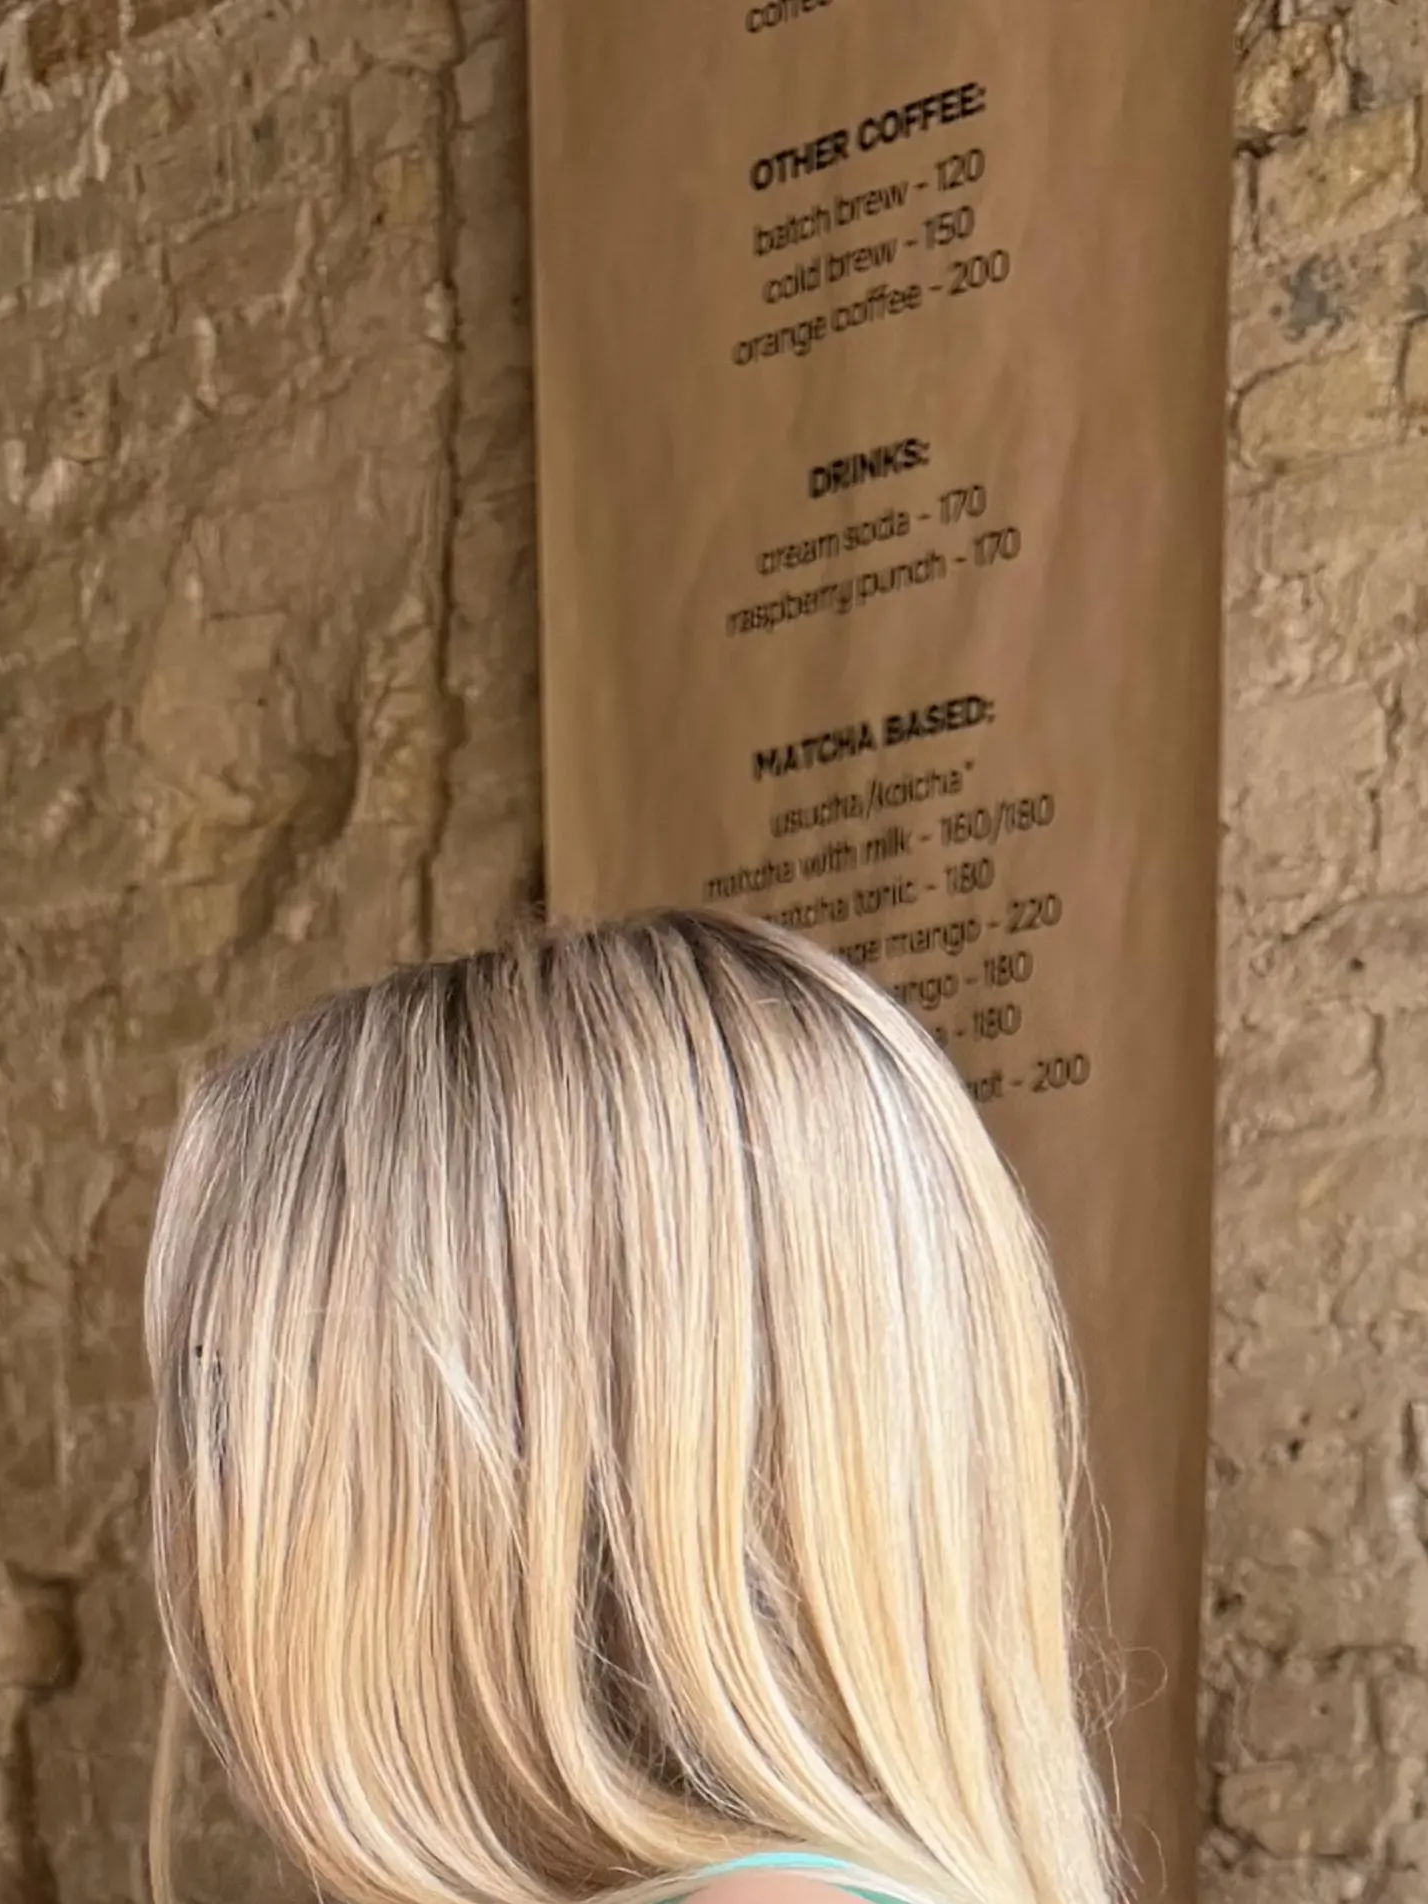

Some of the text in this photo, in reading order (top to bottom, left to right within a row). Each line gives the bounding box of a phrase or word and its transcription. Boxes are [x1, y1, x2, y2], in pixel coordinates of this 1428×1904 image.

[749, 81, 987, 191] OTHER COFFEE:
[752, 205, 832, 257] batch
[834, 180, 910, 227] brew
[934, 147, 986, 192] 120
[762, 256, 822, 304] cold
[827, 237, 900, 284] brew
[922, 204, 976, 249] 150
[731, 315, 828, 366] orange
[830, 283, 922, 333] coffee
[948, 248, 1010, 297] 200
[808, 437, 931, 499] DRINKS:
[756, 532, 840, 576] cream
[843, 507, 911, 551] soda
[938, 483, 987, 526] 170
[725, 578, 854, 638] raspberry
[854, 549, 948, 608] punch
[973, 525, 1022, 567] 170
[753, 694, 997, 783] MATCHA BASED:
[702, 858, 796, 902] matcha
[799, 838, 858, 879] with
[862, 825, 912, 866] milk
[853, 873, 918, 919] tonic
[944, 856, 995, 897] 180
[884, 917, 982, 958] mango
[1005, 892, 1063, 935] 220
[983, 949, 1033, 989] 180
[974, 1002, 1022, 1041] 180
[1031, 1052, 1091, 1094] 200
